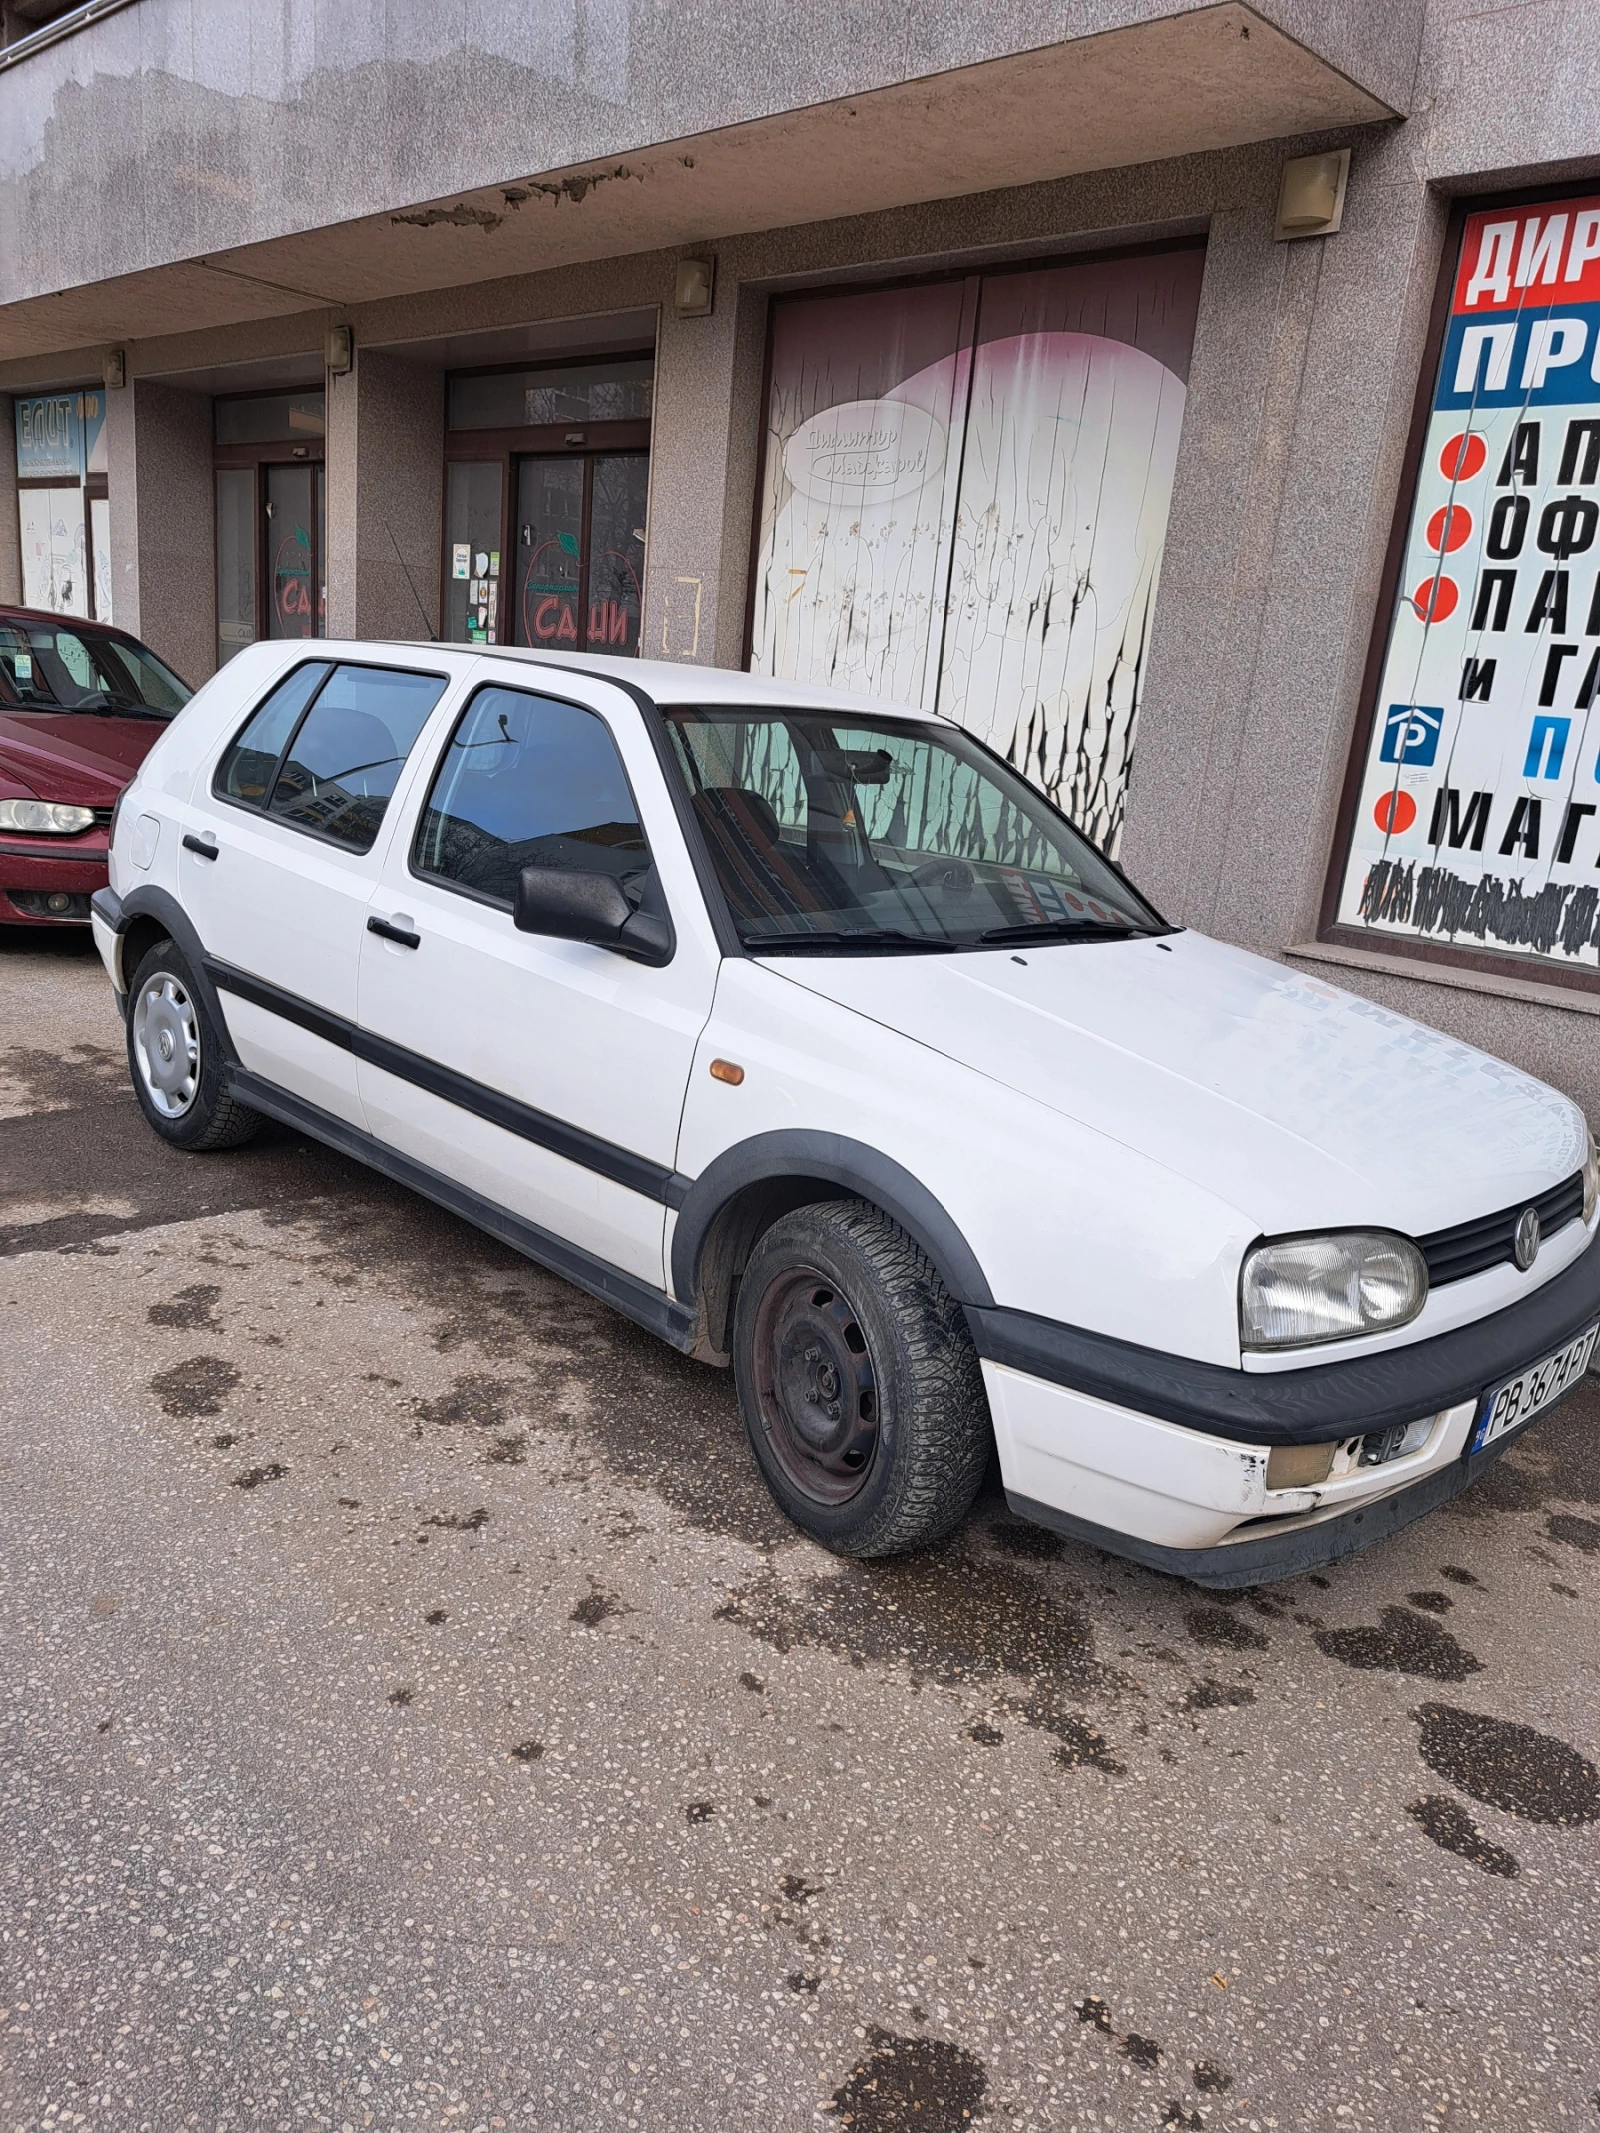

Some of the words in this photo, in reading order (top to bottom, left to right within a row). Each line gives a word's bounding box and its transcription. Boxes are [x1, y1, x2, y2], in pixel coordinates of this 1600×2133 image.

[1453, 318, 1600, 393] ПР
[1471, 568, 1600, 636] ПА
[1522, 715, 1600, 785] П
[1428, 787, 1600, 868] МАГ
[1520, 1349, 1572, 1415] 3674
